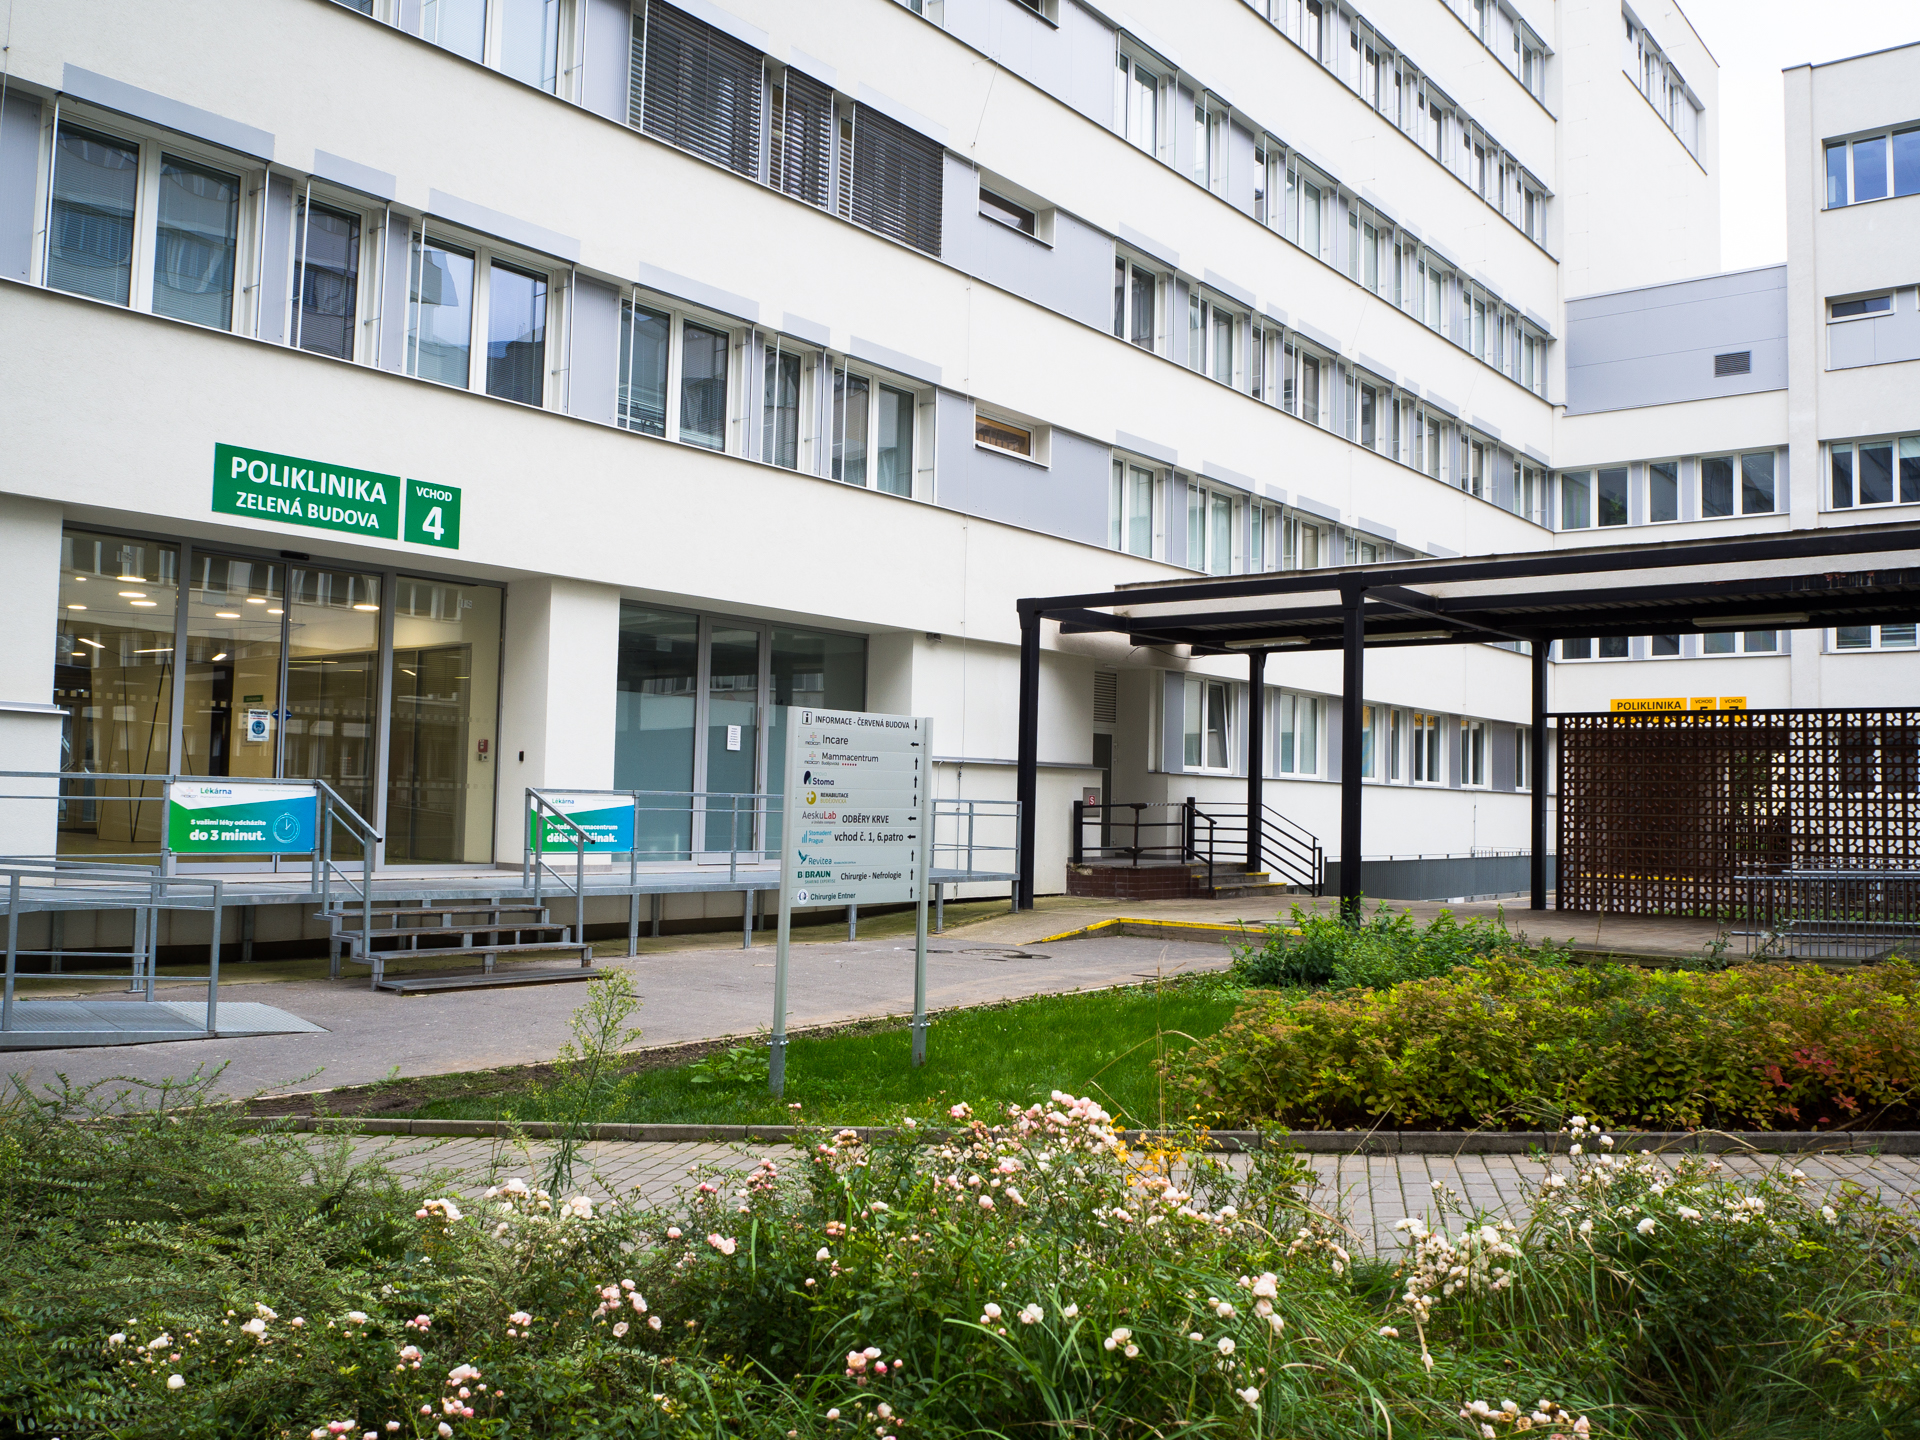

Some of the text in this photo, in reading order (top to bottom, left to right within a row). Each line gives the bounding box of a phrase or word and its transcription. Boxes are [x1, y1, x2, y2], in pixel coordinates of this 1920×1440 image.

[231, 456, 387, 505] POLIKLINIKA
[415, 485, 453, 502] VCHOD
[235, 491, 380, 529] ZELENÁ BUDOVA
[422, 506, 445, 541] 4
[1617, 701, 1682, 711] POLIKLINIKA
[815, 715, 852, 726] INFORMACE
[857, 717, 884, 728] ČERVENÁ
[885, 720, 910, 729] BUDOVA
[822, 735, 849, 745] Incare
[821, 752, 879, 764] Mammacentrum
[812, 777, 835, 786] Stoma
[200, 786, 233, 795] Lékárna
[802, 810, 837, 820] AeskuLab
[842, 812, 890, 824] ODBĚRY KRVE
[219, 818, 234, 827] léky
[234, 818, 267, 826] odcházíte
[189, 828, 266, 841] do 3 minut.
[546, 832, 569, 843] dělá
[834, 832, 904, 843] vchod č. 1, 6.patro
[808, 857, 832, 865] Revitea
[804, 870, 831, 878] BRAUN
[840, 872, 868, 881] Chirurgie
[872, 870, 902, 880] Nefrologie
[810, 892, 856, 902] Chirurgie Entner
